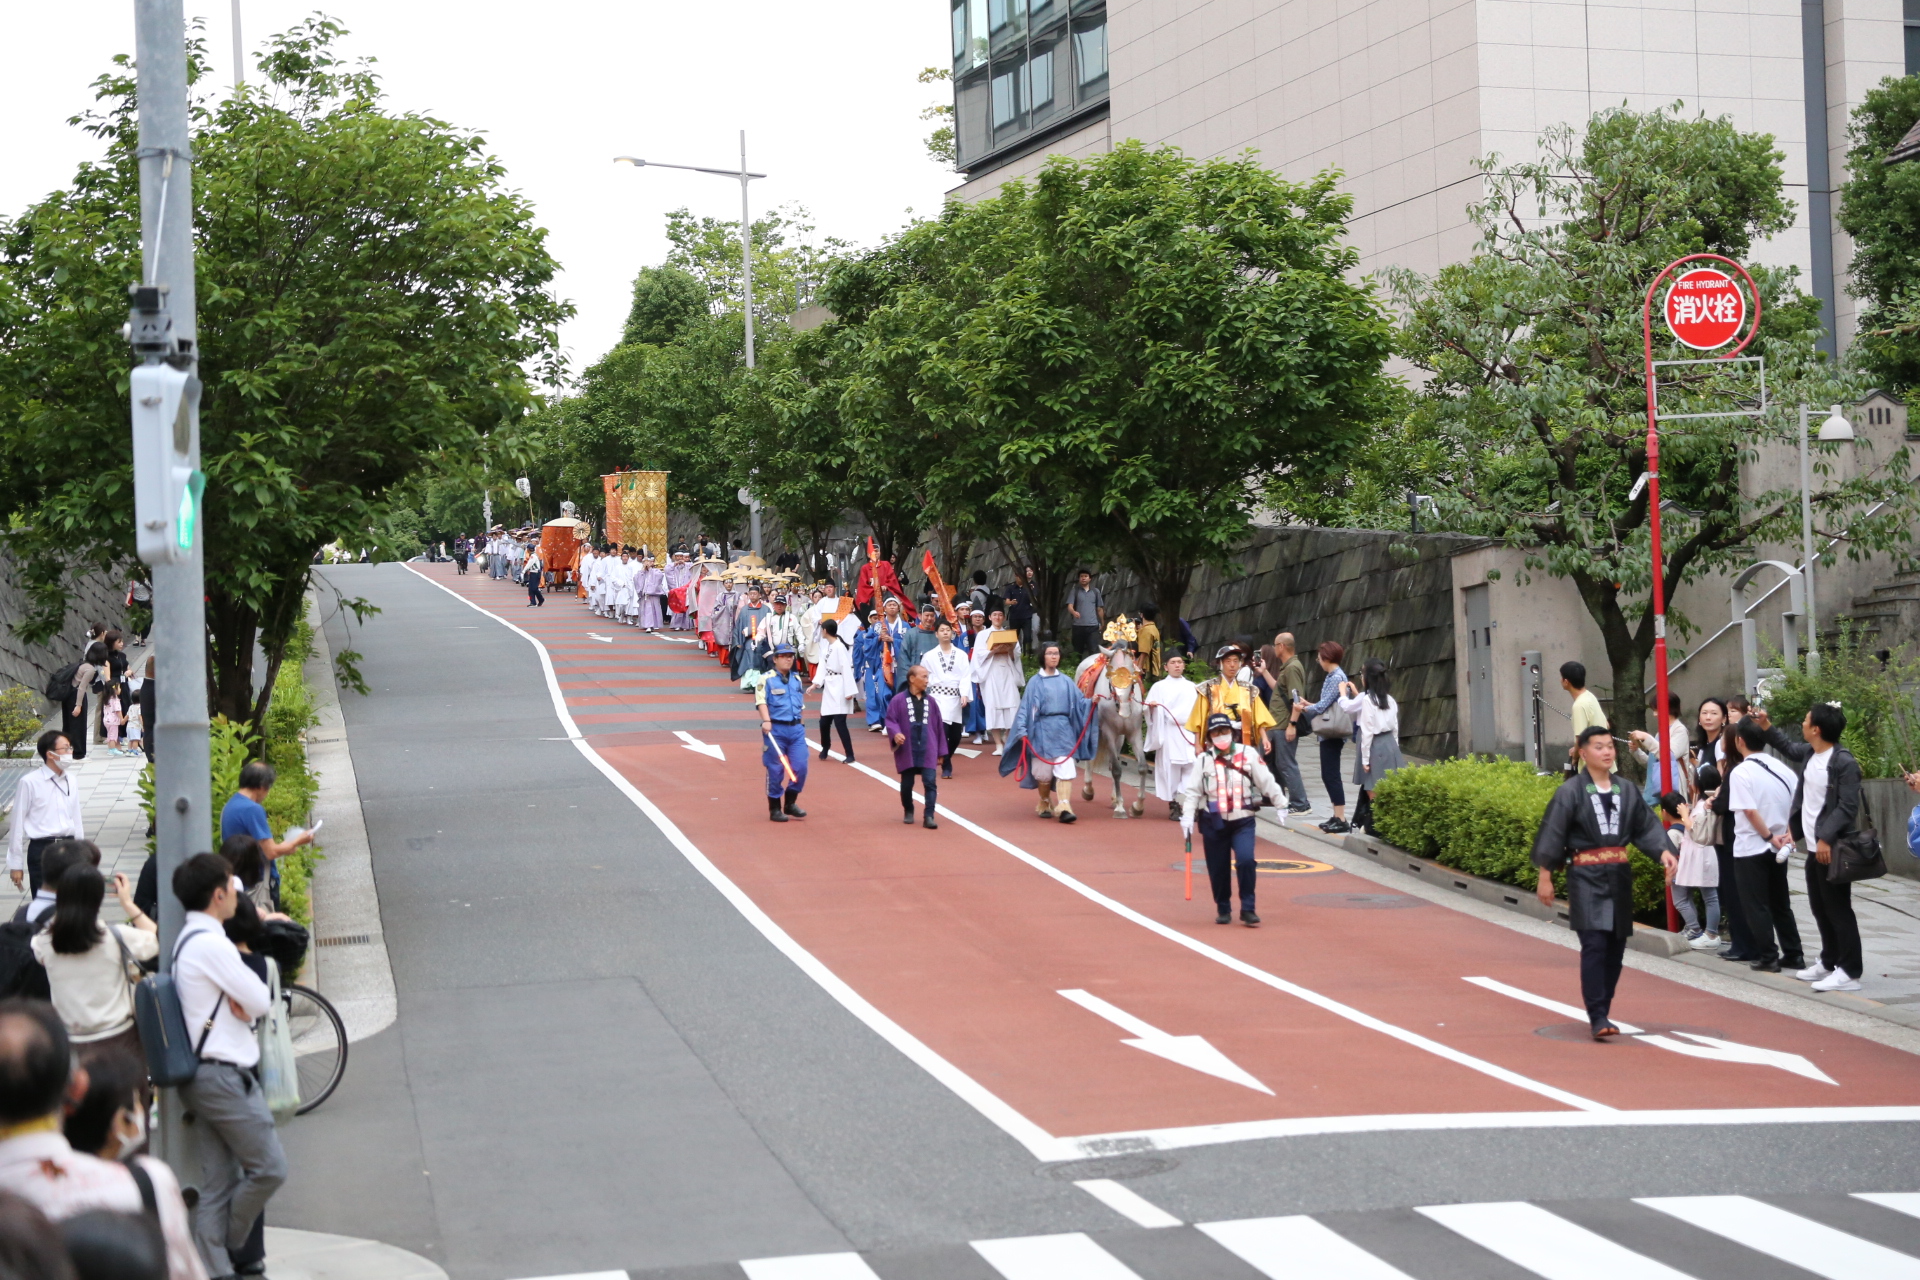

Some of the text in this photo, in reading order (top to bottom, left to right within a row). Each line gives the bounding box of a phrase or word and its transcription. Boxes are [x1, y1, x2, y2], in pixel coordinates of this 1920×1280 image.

[1678, 280, 1729, 290] FIRE HYDRANT
[1673, 293, 1738, 325] 消火栓
